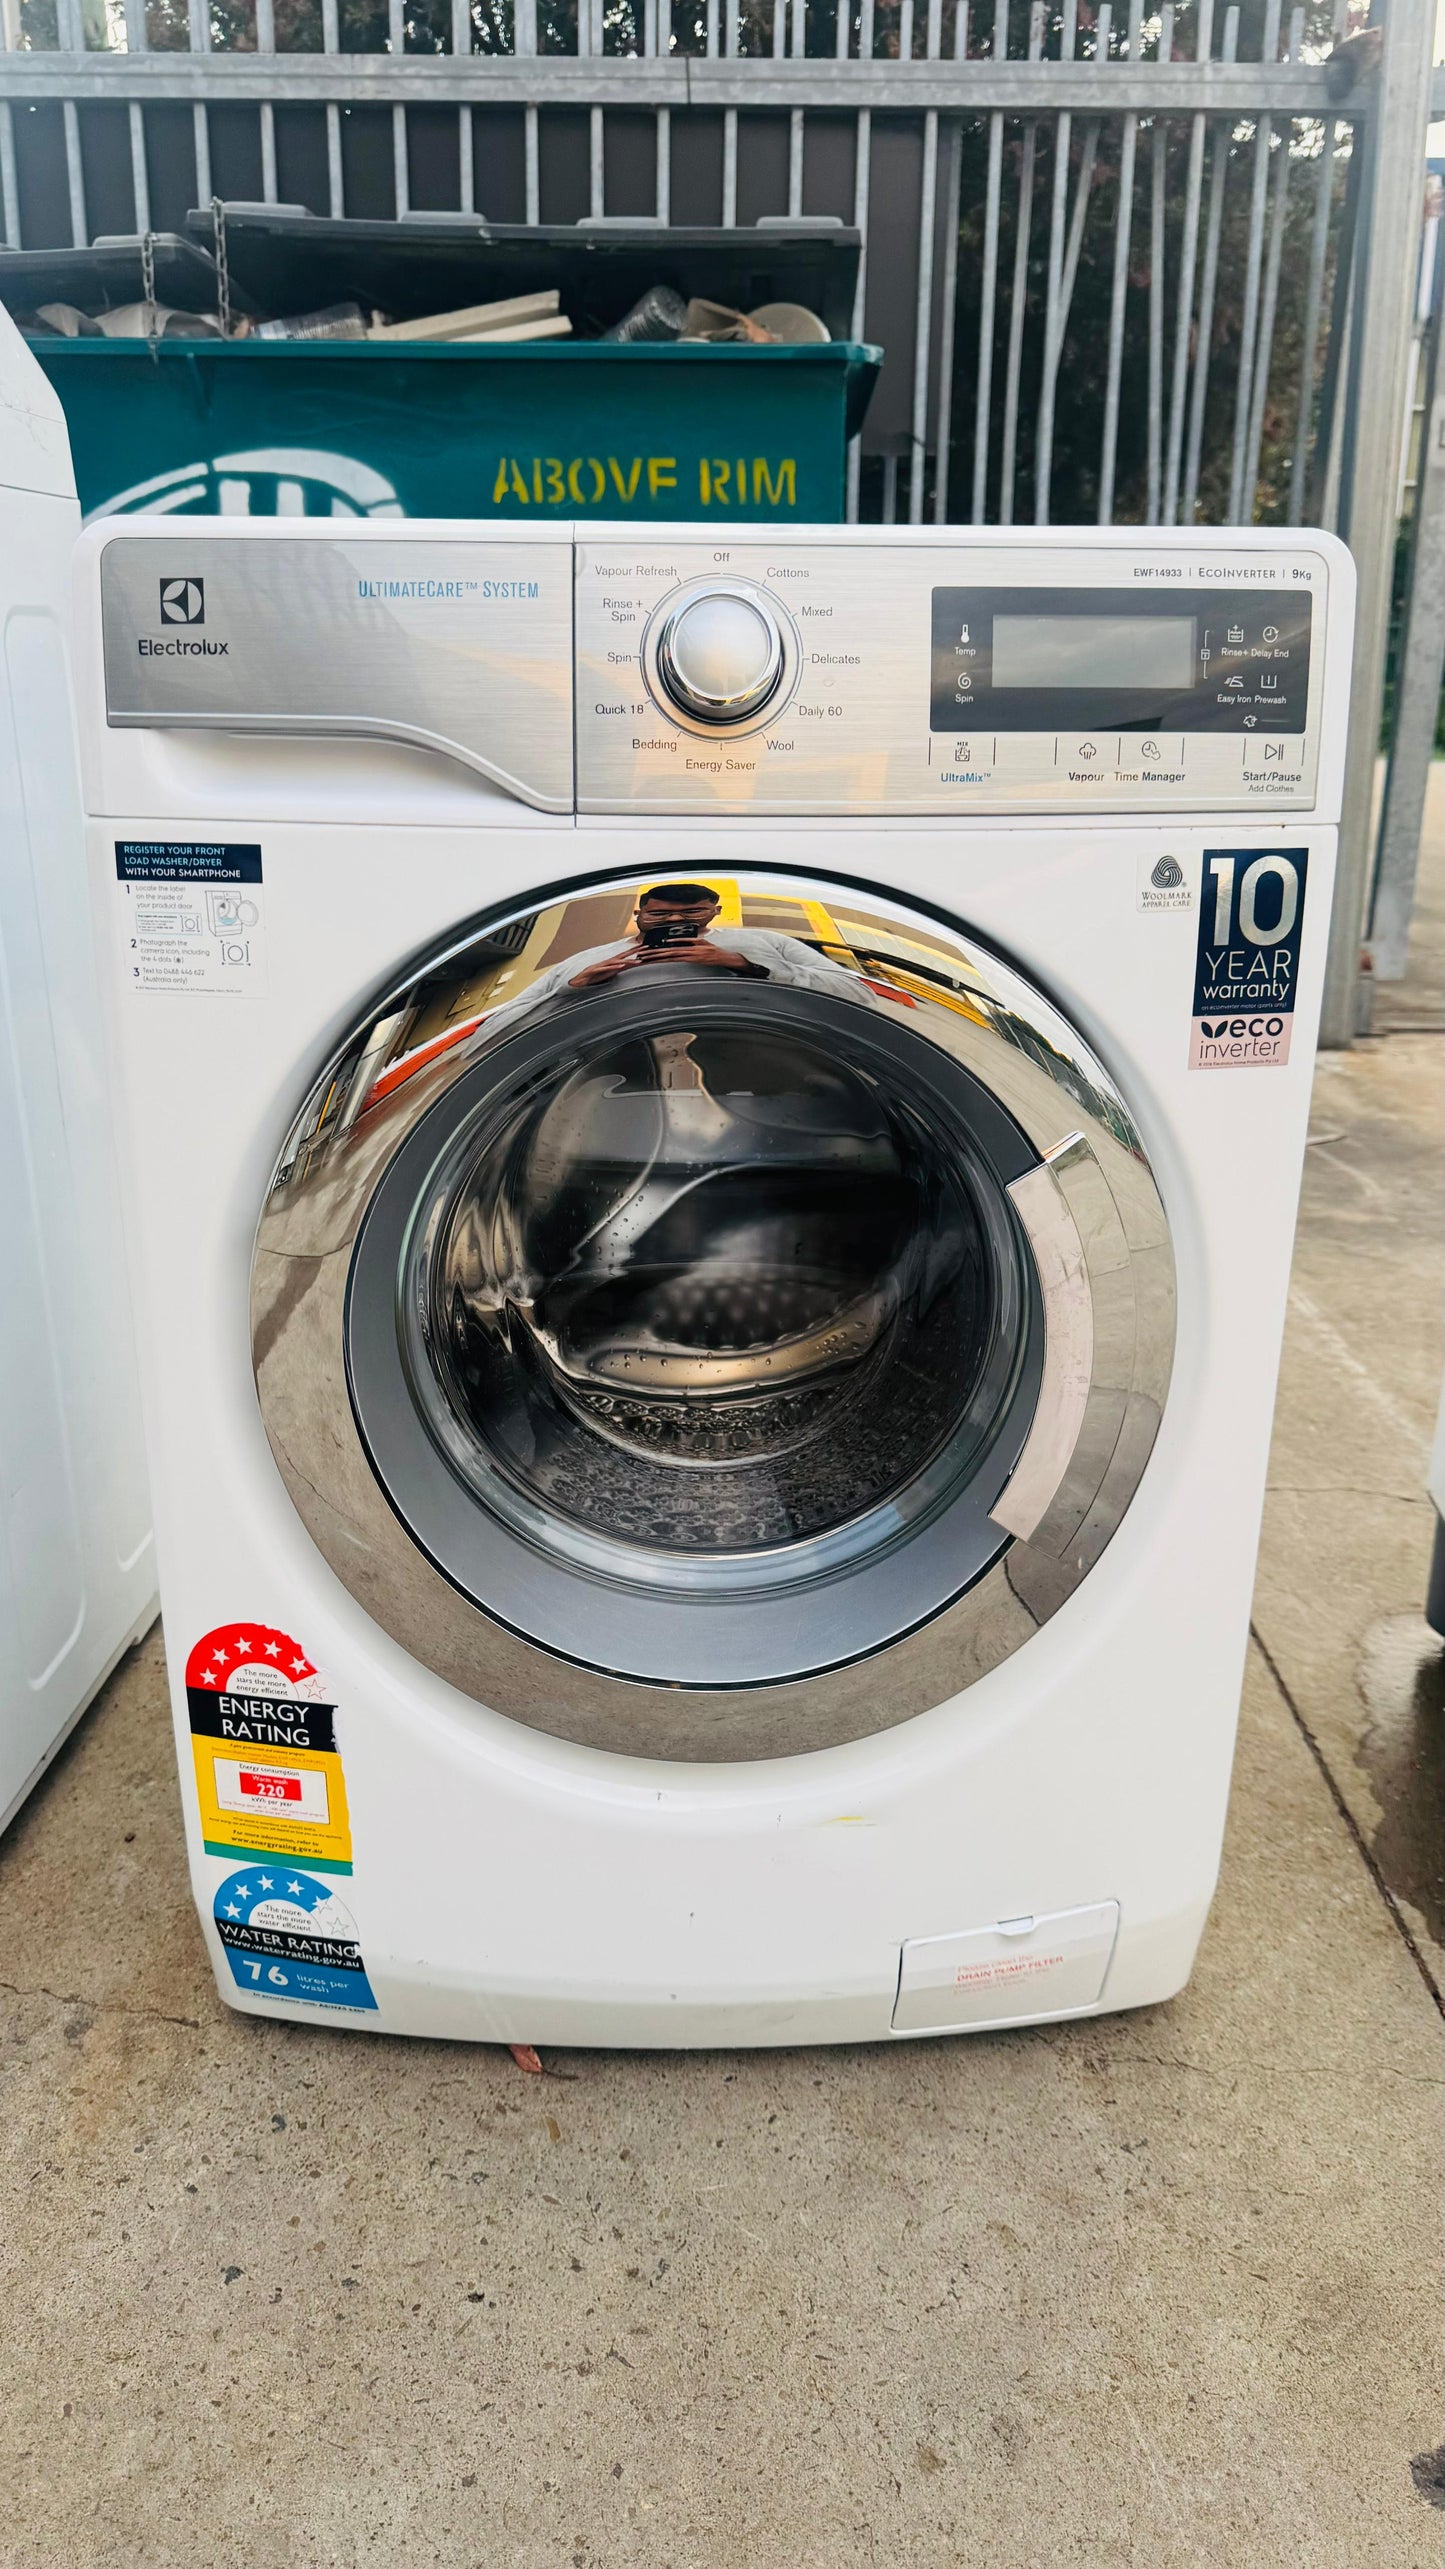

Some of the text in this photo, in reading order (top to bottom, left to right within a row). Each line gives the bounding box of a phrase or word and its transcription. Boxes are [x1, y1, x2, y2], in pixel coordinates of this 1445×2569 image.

[698, 457, 797, 507] RIM
[713, 552, 731, 563] Off
[595, 565, 678, 578] Vapour Refresh
[766, 567, 810, 578] Cottons
[1133, 568, 1183, 578] EWF14933
[1291, 569, 1312, 581] 9Kg
[602, 598, 633, 610] Rinse
[611, 611, 636, 624] Spin
[801, 606, 833, 618] Mixed
[138, 638, 230, 657] Electrolux
[954, 646, 976, 658] Temp
[1250, 648, 1272, 660] Delay
[1274, 649, 1290, 658] End
[607, 651, 632, 665] Spin
[811, 653, 861, 665] Delicates
[954, 693, 974, 705] Spin
[1217, 695, 1287, 706] Easy Iron Prewash
[595, 703, 644, 716] Quick 18
[799, 705, 843, 719] Daily 60
[632, 738, 677, 752] Bedding
[766, 740, 795, 751] Wool
[685, 759, 757, 773] Energy Saver
[1068, 771, 1105, 784] Vapour
[1114, 771, 1186, 784] Time Manager
[1242, 771, 1302, 783] Start/Pause
[1248, 784, 1295, 793] Add Clothes
[124, 845, 226, 856] REGISTER YOUR FRONT
[124, 857, 222, 867] LOAD WASHER/DRYER
[125, 867, 241, 878] WITH YOUR SMARTPHONE
[126, 884, 130, 894] 1
[135, 884, 157, 892] Locate
[152, 902, 177, 910] product
[1209, 855, 1299, 946] 10
[130, 938, 138, 948] 2
[1205, 949, 1292, 981] YEAR
[133, 967, 140, 977] 3
[1202, 979, 1290, 1001] warranty
[1229, 1017, 1284, 1038] eco
[1199, 1038, 1281, 1059] inverter
[259, 1671, 278, 1679] more
[267, 1680, 287, 1688] more
[236, 1685, 289, 1697] energy efficient
[218, 1695, 310, 1724] ENERGY
[221, 1718, 311, 1747] RATING
[239, 1763, 260, 1773] Energy
[252, 1775, 273, 1784] Warm
[256, 1782, 286, 1798] 220
[264, 1903, 302, 1917] The more
[257, 1910, 312, 1926] stars the more
[258, 1919, 280, 1928] water
[219, 1922, 284, 1948] WATER
[223, 1935, 360, 1969] www.waterrating.gov.au
[242, 1959, 289, 1987] 76
[957, 1969, 992, 1982] DRAIN
[993, 1963, 1026, 1975] PUMP
[1028, 1955, 1064, 1969] FILTER
[296, 1973, 350, 1991] litres per
[299, 1983, 330, 1994] wash
